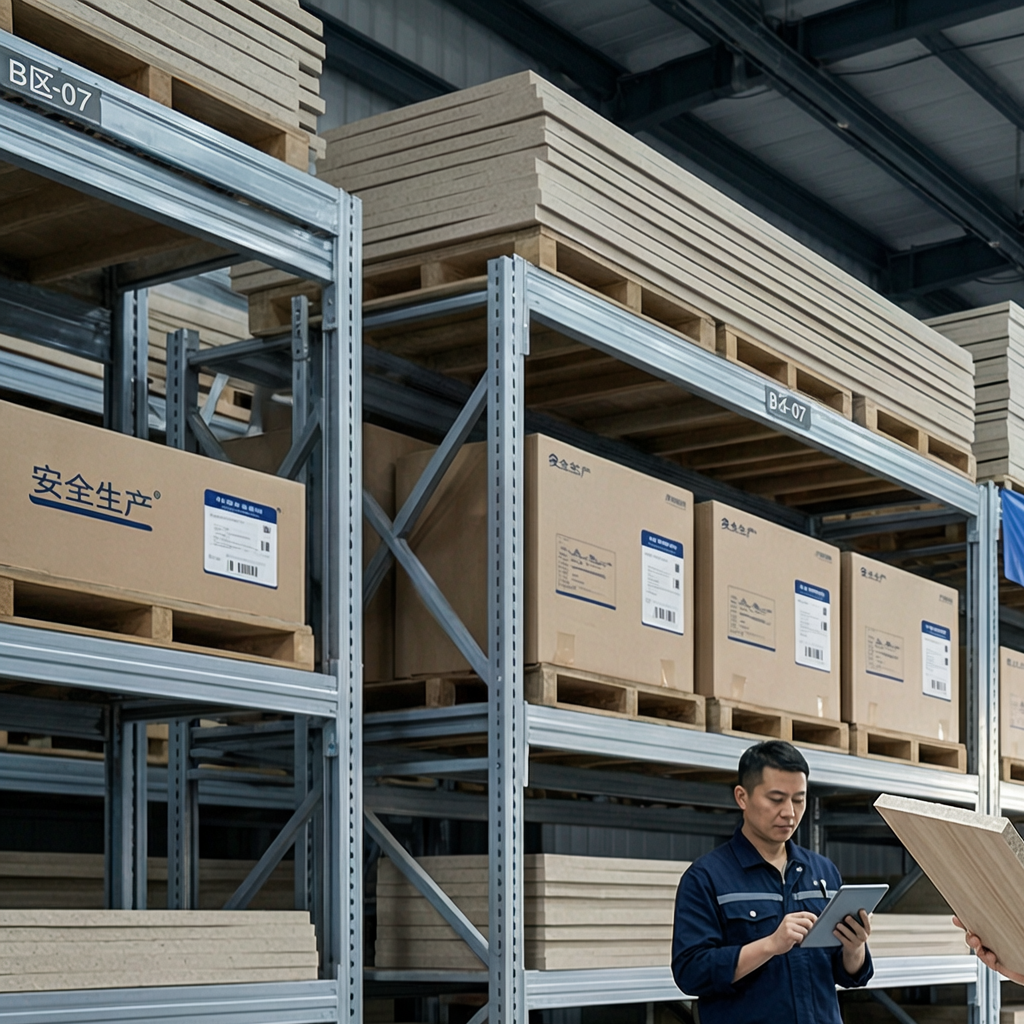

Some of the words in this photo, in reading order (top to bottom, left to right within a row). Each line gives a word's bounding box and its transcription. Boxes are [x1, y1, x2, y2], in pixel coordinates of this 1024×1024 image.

[9, 58, 92, 111] B区-07
[32, 464, 153, 516] 安全生产
